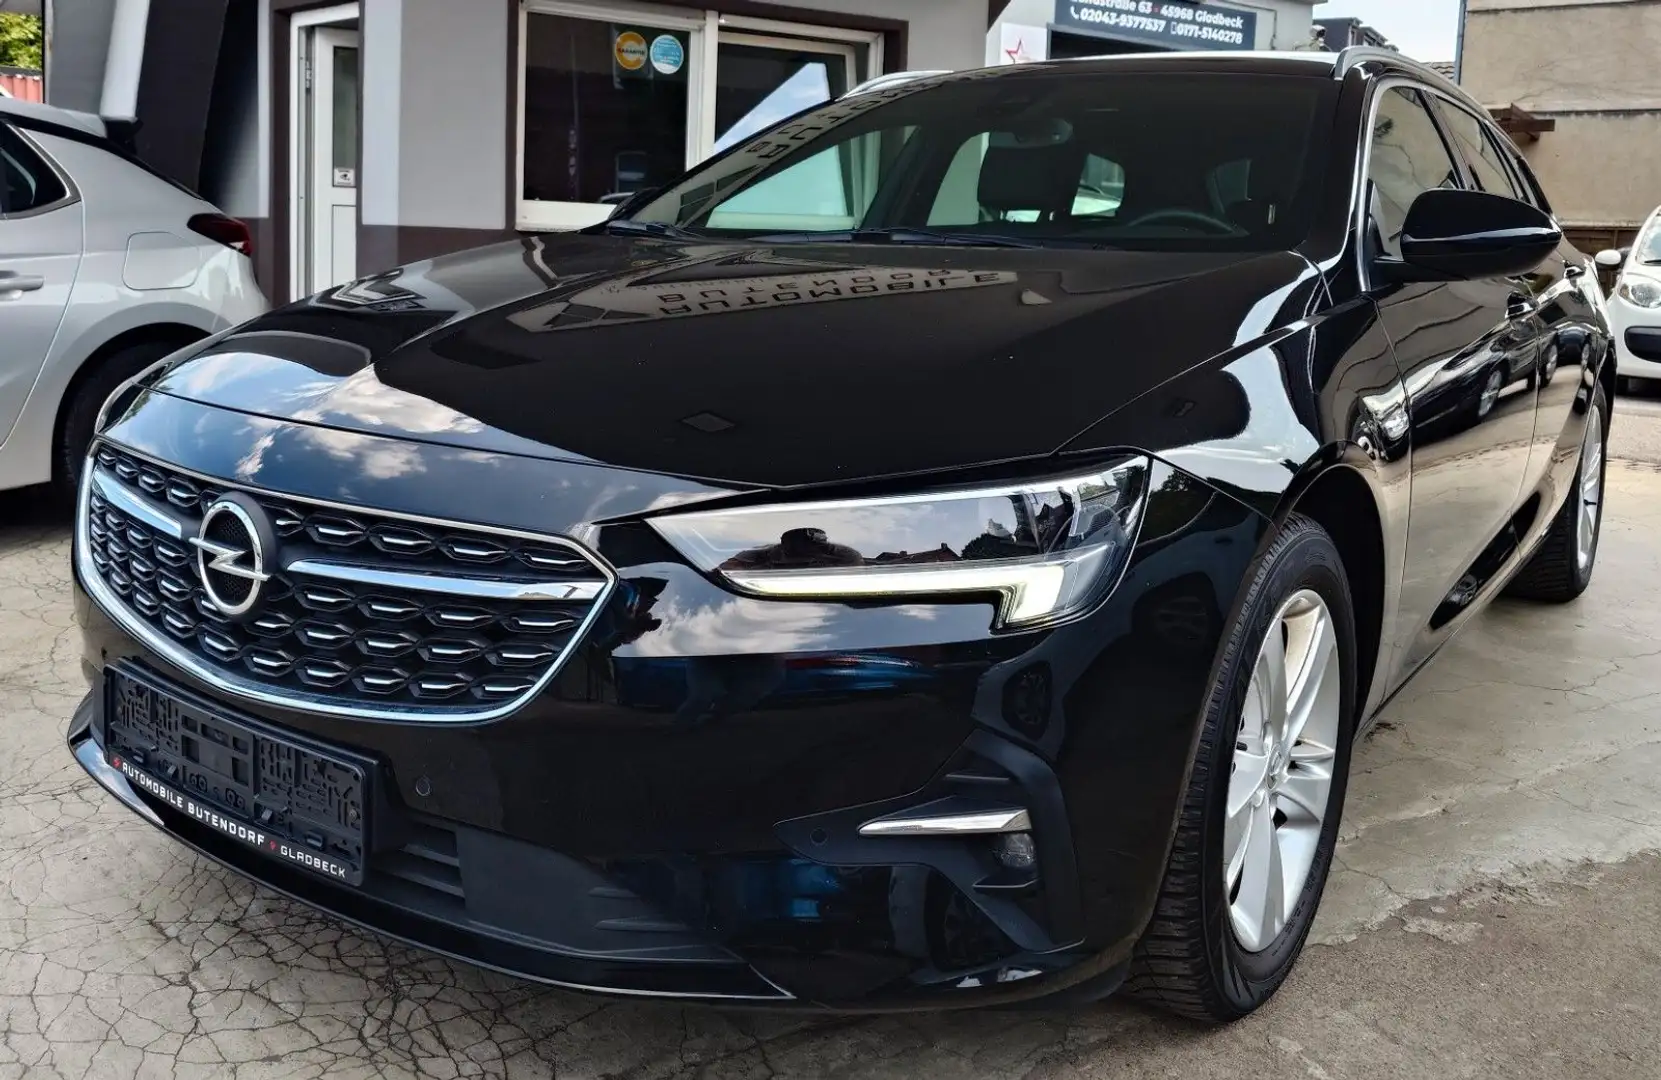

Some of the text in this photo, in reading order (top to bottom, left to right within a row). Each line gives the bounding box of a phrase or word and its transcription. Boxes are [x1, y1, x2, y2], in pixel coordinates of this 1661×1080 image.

[1138, 1, 1153, 14] 63
[1160, 5, 1194, 20] 45968
[1195, 10, 1244, 29] Gladbeck
[122, 762, 347, 879] AUTOMOBILE BUTENDORF GLADBECK
